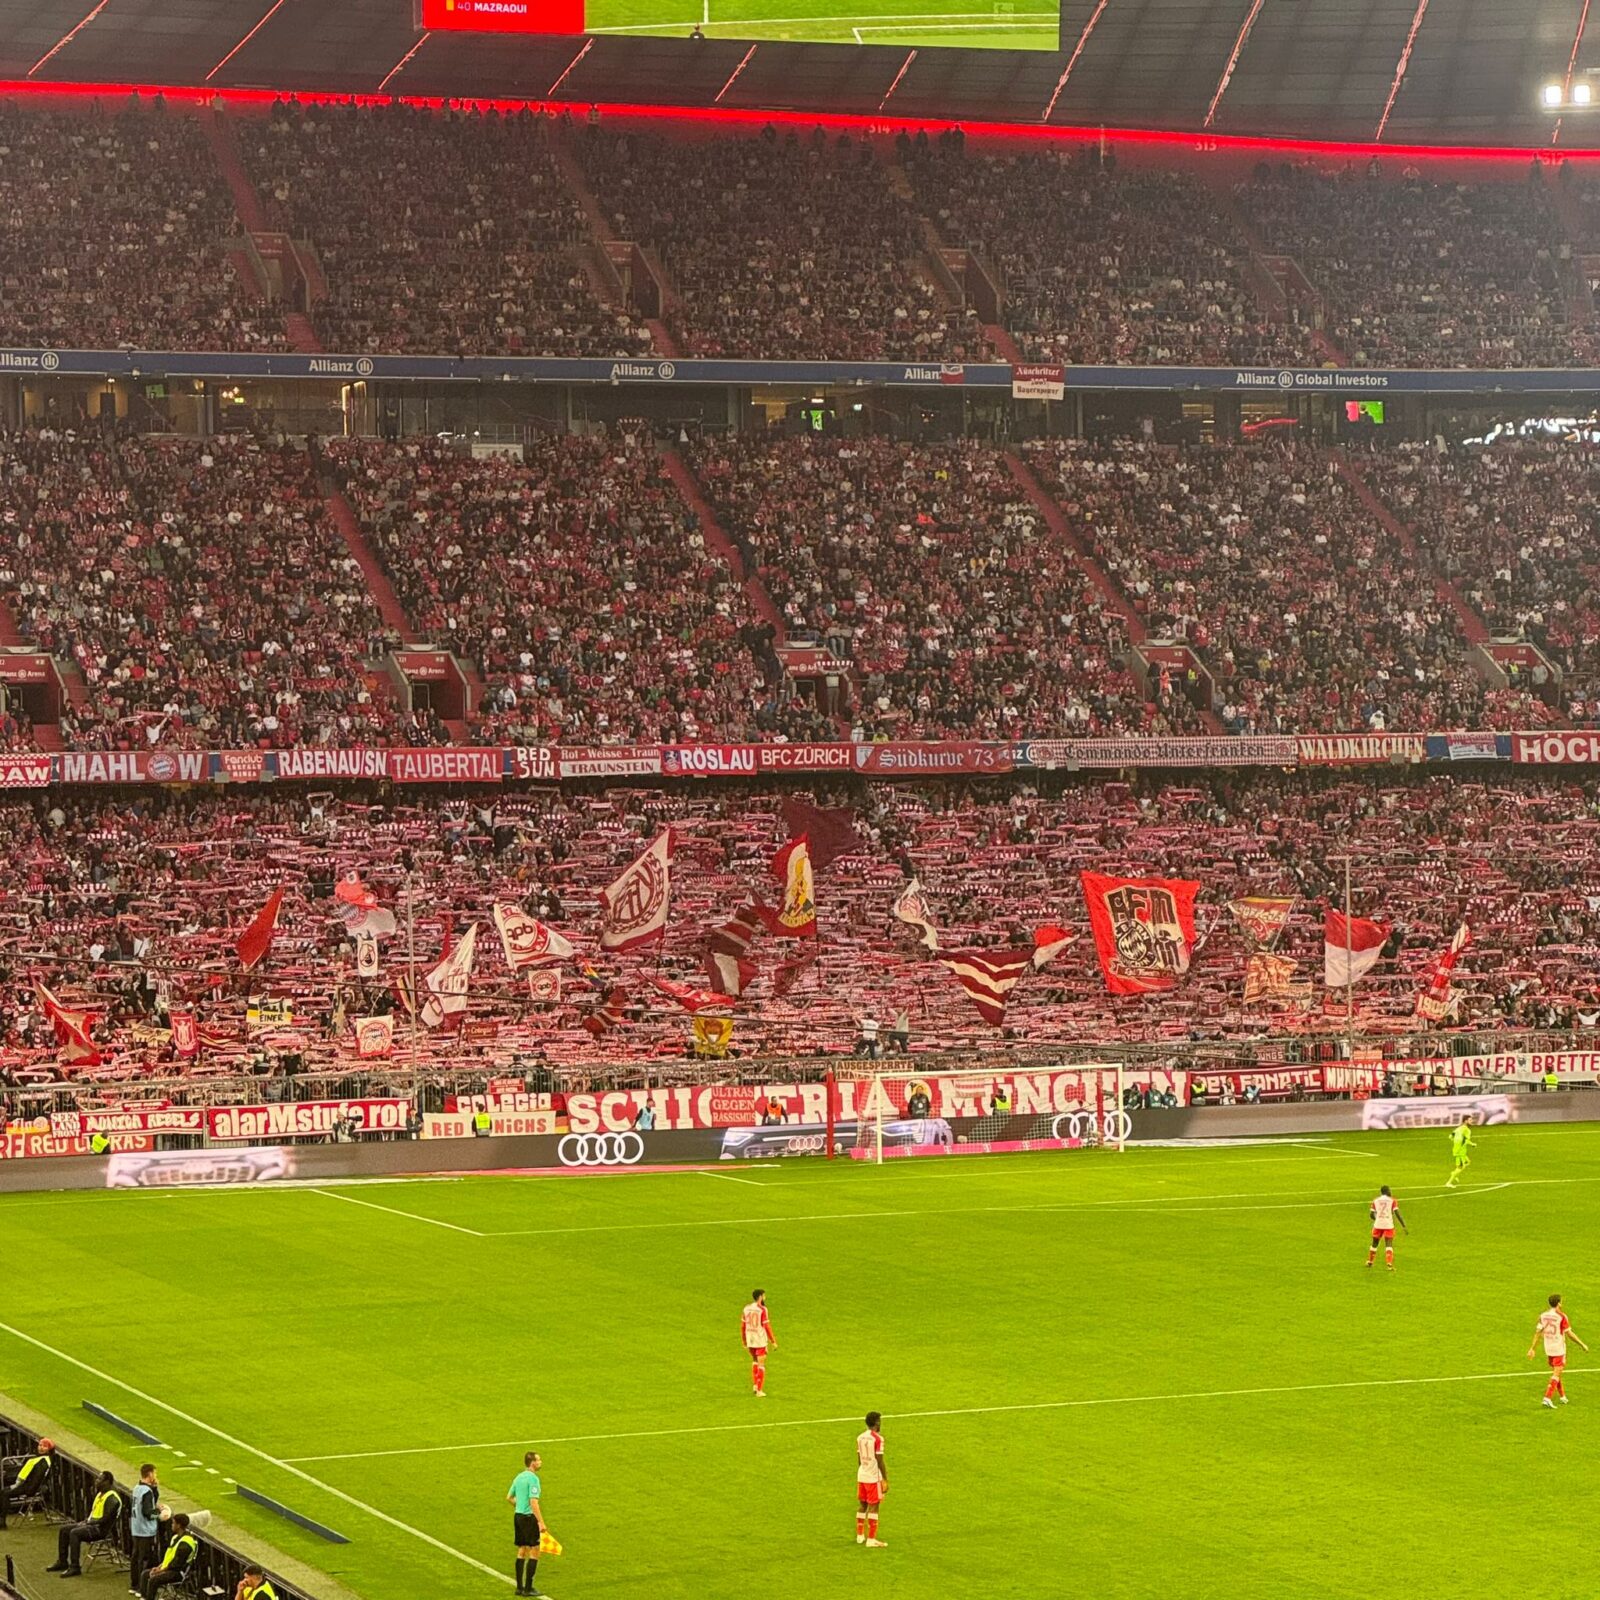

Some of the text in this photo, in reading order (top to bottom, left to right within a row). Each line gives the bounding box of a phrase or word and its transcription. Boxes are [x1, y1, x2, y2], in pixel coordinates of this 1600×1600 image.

[457, 2, 527, 14] 40 MAZRAOUI
[0, 354, 38, 366] llianz
[309, 360, 353, 371] Allianz
[611, 364, 655, 376] Allianz
[904, 368, 942, 380] Allian
[1236, 373, 1388, 385] Allianz Global Investors
[517, 748, 551, 762] RED
[561, 750, 578, 760] Rot
[588, 748, 622, 759] Weisse
[1300, 737, 1425, 760] WALDKIRCHEN
[224, 754, 263, 764] Fanclub
[681, 746, 755, 771] RÖSLAU
[761, 746, 849, 765] BFC ZÜRICH
[879, 748, 964, 768] Südkurve
[64, 754, 146, 781] MAHL
[178, 754, 204, 780] W
[279, 751, 387, 776] RABENAU/SN
[393, 753, 501, 779] TAUBERTAL
[520, 761, 555, 778] SUN
[570, 761, 654, 773] TRAUNSTEIN
[712, 1087, 755, 1097] ULTRAS
[712, 1100, 755, 1111] GEGEN
[369, 1102, 409, 1128] rot
[712, 1111, 756, 1123] RASSISMUS
[52, 1121, 81, 1131] LAND
[432, 1122, 464, 1137] RED
[31, 1134, 68, 1155] RED
